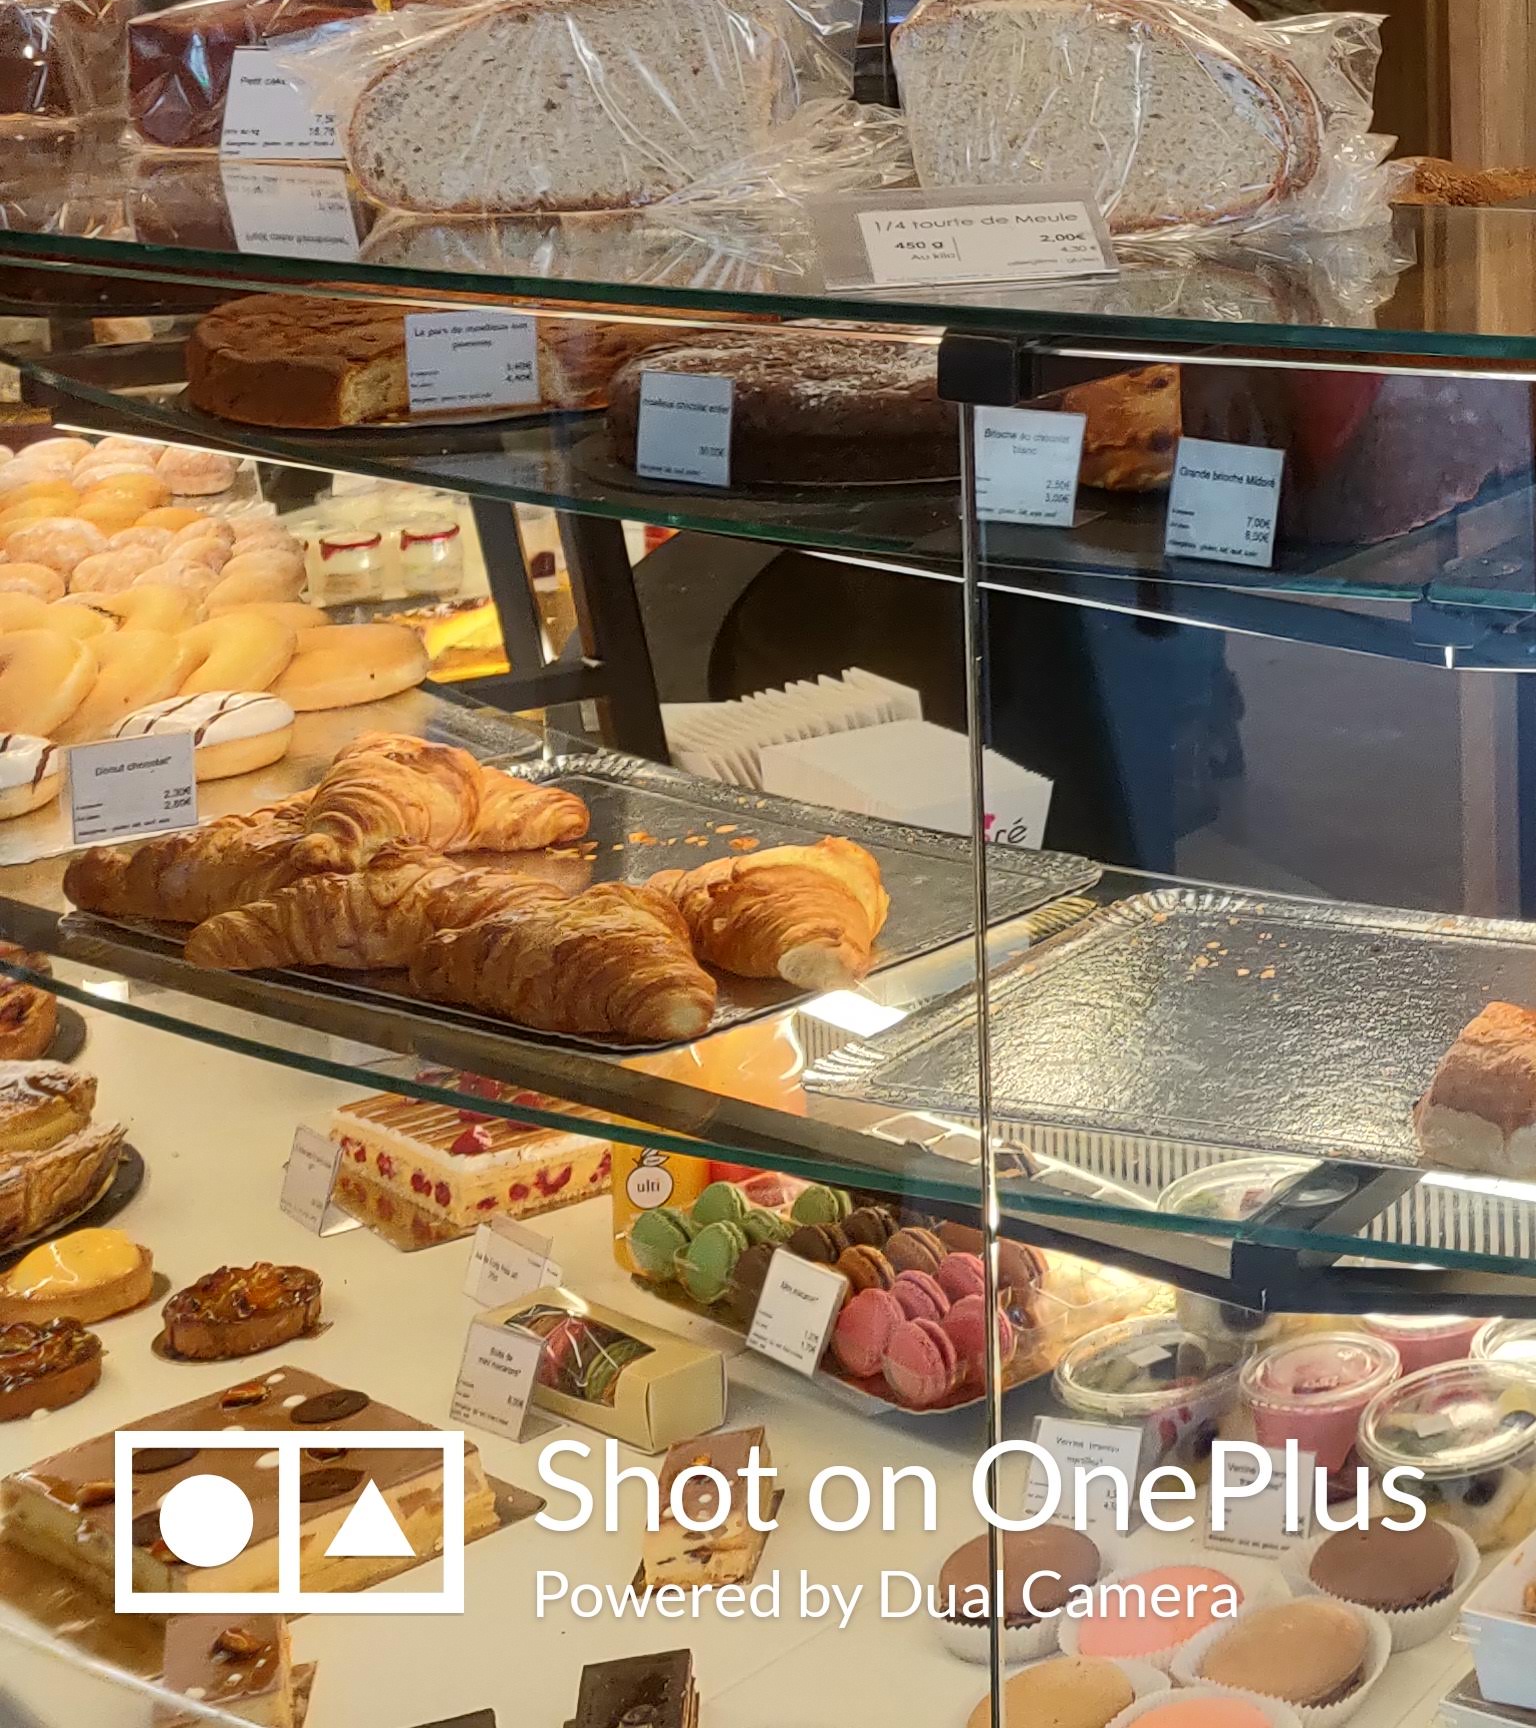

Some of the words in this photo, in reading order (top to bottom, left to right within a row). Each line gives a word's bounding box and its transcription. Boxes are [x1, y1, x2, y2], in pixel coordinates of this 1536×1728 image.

[875, 220, 906, 233] 1/4
[980, 215, 1009, 226] de
[1015, 212, 1078, 224] Meule
[894, 241, 926, 249] 450
[931, 241, 944, 250] g
[1179, 466, 1212, 481] Grande
